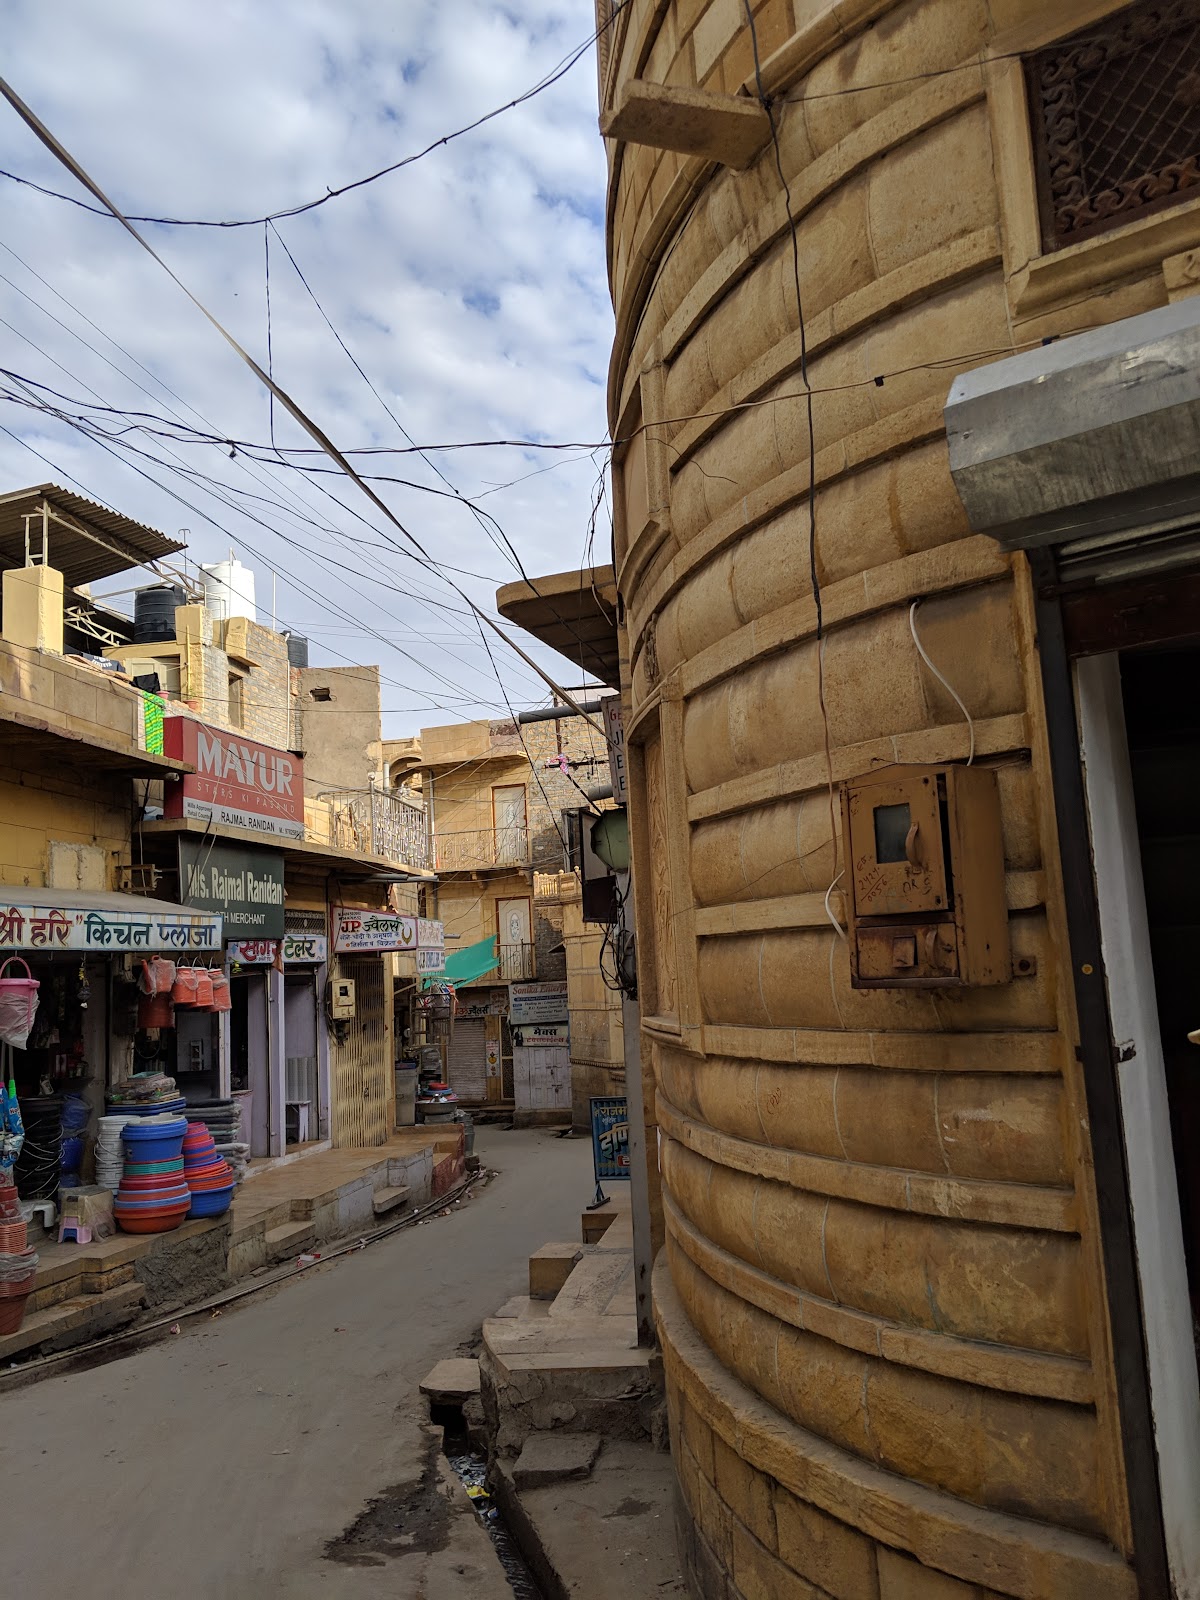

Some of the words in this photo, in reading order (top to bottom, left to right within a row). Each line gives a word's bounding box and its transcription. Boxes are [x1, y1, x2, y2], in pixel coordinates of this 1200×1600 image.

[197, 731, 293, 796] MAYUR
[197, 782, 233, 799] STARS
[242, 794, 249, 803] KI
[256, 796, 295, 813] PASAND
[221, 811, 247, 827] RAJMAL
[248, 818, 275, 832] RANIDAN
[211, 867, 245, 909] Rajmal
[247, 871, 282, 905] Ranidan
[84, 913, 152, 945] किचन
[157, 923, 216, 946] प्लाजा
[230, 912, 265, 925] MERCHANT
[513, 985, 538, 995] Sonika
